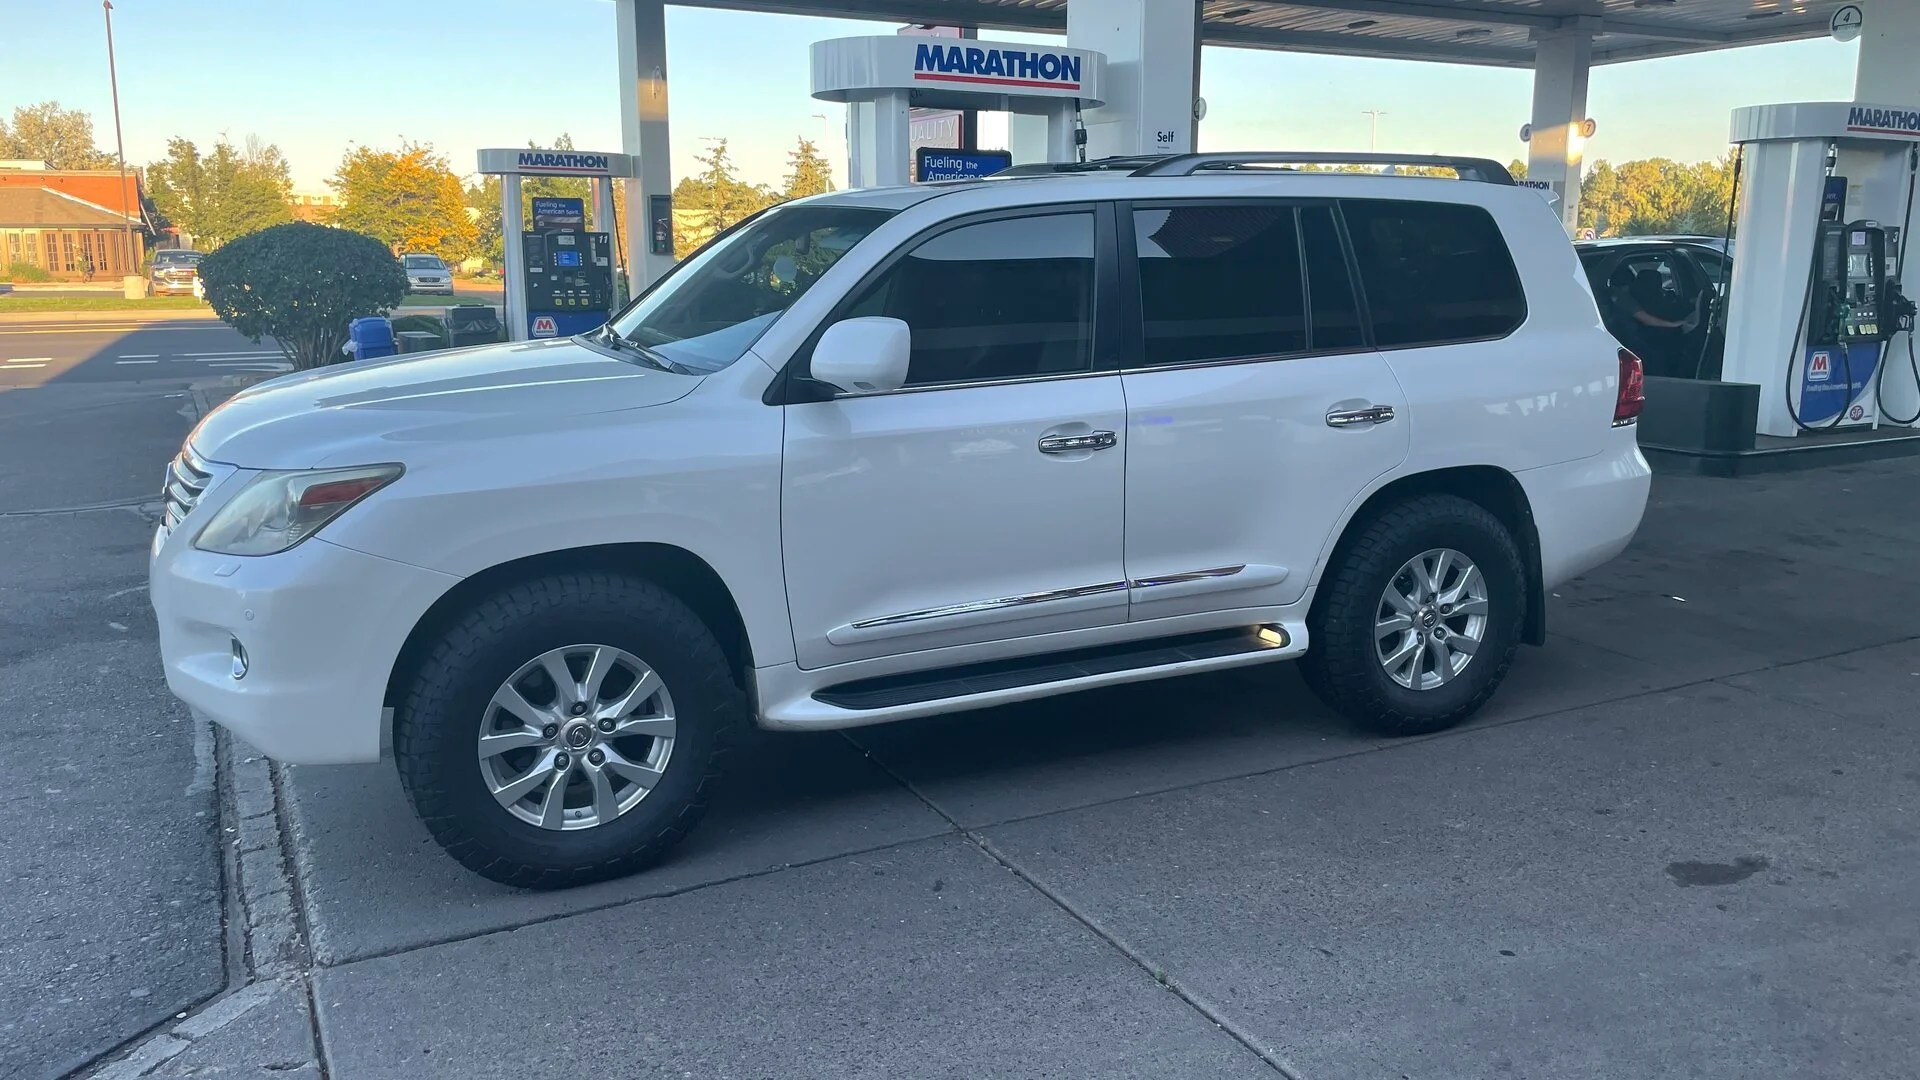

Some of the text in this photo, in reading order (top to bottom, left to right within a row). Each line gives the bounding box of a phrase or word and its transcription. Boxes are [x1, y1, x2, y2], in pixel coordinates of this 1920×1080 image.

[1843, 12, 1850, 22] 4
[914, 43, 1080, 81] MARATHON
[1848, 107, 1920, 130] MARATHO
[910, 118, 955, 141] UALITY
[1586, 124, 1591, 133] 7
[1157, 131, 1174, 143] Self
[518, 153, 608, 168] MARATHON
[924, 155, 978, 171] Fueling the
[1515, 181, 1550, 190] RATHON
[598, 235, 608, 244] 11
[1892, 231, 1899, 243] 3
[537, 320, 553, 330] M
[1812, 356, 1827, 370] M
[1850, 407, 1862, 418] STP
